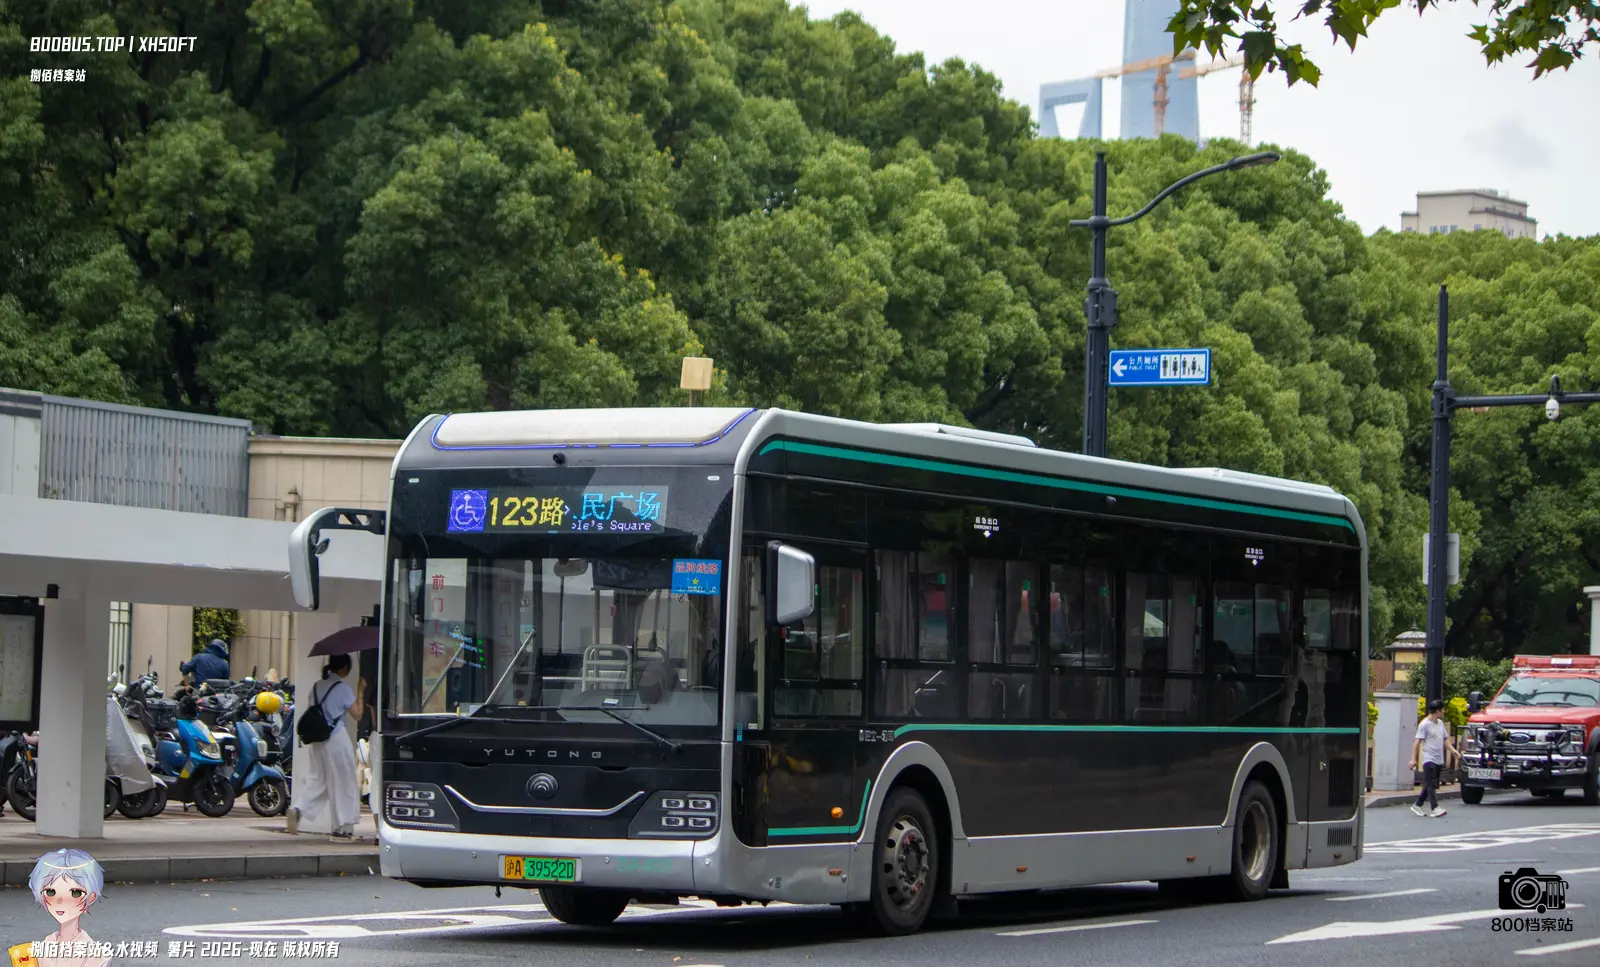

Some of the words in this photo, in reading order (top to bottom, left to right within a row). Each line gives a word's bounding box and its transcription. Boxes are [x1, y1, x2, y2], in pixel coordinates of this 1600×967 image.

[490, 496, 565, 526] 123路
[572, 491, 661, 520] 民广场
[610, 520, 652, 531] Square
[484, 748, 602, 759] YUTONG
